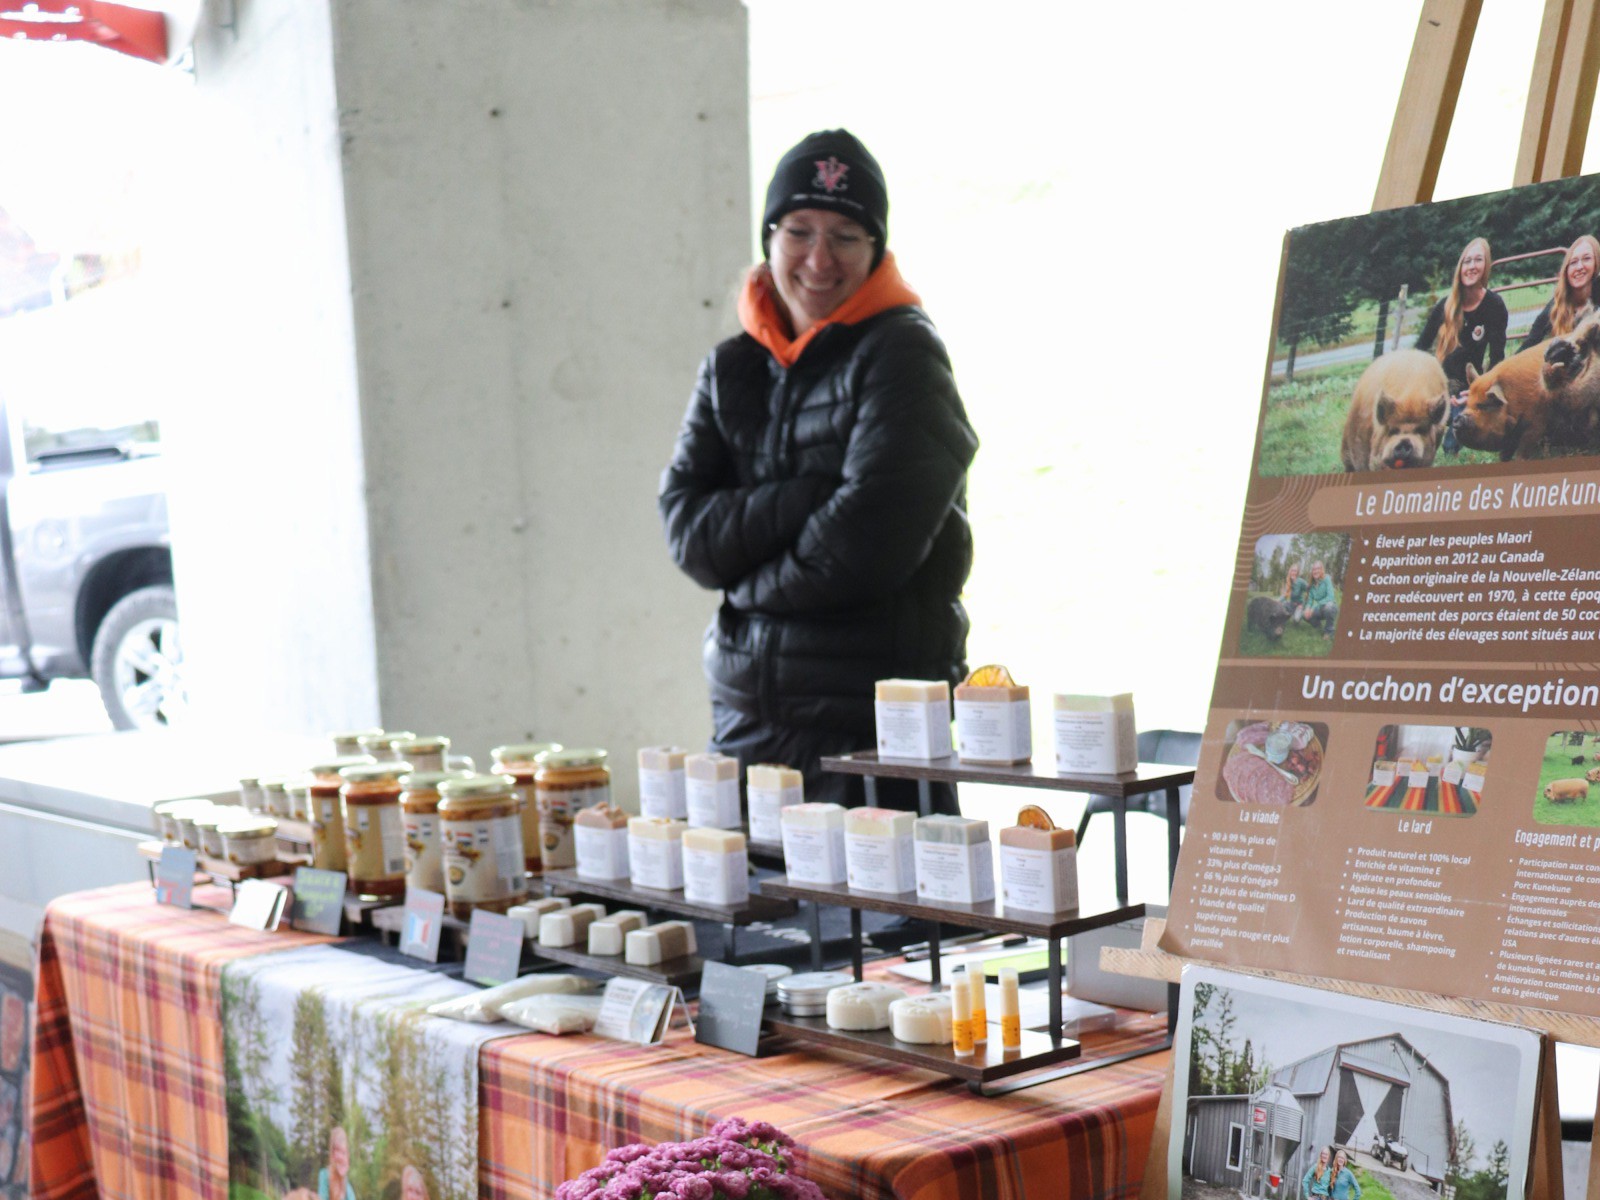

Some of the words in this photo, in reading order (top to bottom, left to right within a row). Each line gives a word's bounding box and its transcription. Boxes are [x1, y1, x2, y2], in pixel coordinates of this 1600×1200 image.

[1356, 492, 1376, 516] Le
[1382, 486, 1462, 515] Domaine
[1469, 483, 1504, 510] des
[1510, 478, 1600, 508] Kunekun
[1376, 534, 1405, 548] Élevé
[1407, 538, 1427, 550] par
[1429, 535, 1445, 546] les
[1447, 533, 1494, 549] peuples
[1497, 531, 1532, 544] Maori
[1372, 554, 1432, 569] Apparition
[1435, 556, 1449, 565] en
[1451, 552, 1479, 564] 2012
[1481, 554, 1496, 564] au
[1500, 550, 1544, 563] Canada
[1370, 573, 1410, 585] Cochon
[1413, 572, 1468, 587] originaire
[1471, 571, 1486, 583] de
[1489, 570, 1499, 582] la
[1366, 592, 1391, 603] Porc
[1394, 591, 1464, 603] redécouvert
[1468, 593, 1482, 602] en
[1488, 590, 1517, 603] 1970,
[1522, 589, 1529, 601] à
[1534, 590, 1566, 601] cette
[1363, 611, 1436, 622] recencement
[1439, 609, 1459, 621] des
[1461, 612, 1494, 624] porcs
[1496, 609, 1540, 621] étaient
[1543, 608, 1558, 620] de
[1561, 609, 1576, 620] 50
[1360, 629, 1372, 640] La
[1375, 628, 1423, 643] majorité
[1426, 628, 1445, 640] des
[1448, 628, 1499, 643] élevages
[1501, 630, 1529, 640] sont
[1531, 628, 1568, 640] situés
[1571, 631, 1595, 640] aux
[1302, 675, 1334, 699] Un
[1342, 675, 1432, 702] cochon
[1240, 810, 1249, 822] La
[1252, 810, 1279, 824] viande
[1398, 819, 1409, 832] Le
[1411, 820, 1432, 834] lard
[1515, 829, 1577, 847] Engagement
[1580, 835, 1592, 848] et
[1358, 847, 1386, 857] Produit
[1388, 851, 1417, 860] naturel
[1418, 853, 1427, 861] et
[1429, 853, 1449, 862] 100%
[1451, 855, 1471, 865] local
[1519, 858, 1568, 869] Participation
[1355, 859, 1386, 870] Enrichie
[1387, 863, 1397, 871] de
[1399, 864, 1434, 874] vitamine
[1436, 867, 1441, 875] E
[1352, 872, 1383, 882] Hydrate
[1396, 877, 1442, 888] profondeur
[1514, 881, 1531, 889] Porc
[1532, 883, 1571, 893] Kunekune
[1349, 885, 1376, 894] Apaise
[1376, 887, 1388, 895] les
[1389, 890, 1414, 898] peaux
[1414, 892, 1452, 902] sensibles
[1347, 897, 1365, 906] Lard
[1366, 899, 1376, 907] de
[1377, 901, 1405, 910] qualité
[1406, 904, 1464, 917] extraordinaire
[1345, 909, 1387, 921] Production
[1388, 914, 1398, 922] de
[1400, 917, 1427, 926] savons
[1502, 939, 1516, 947] USA
